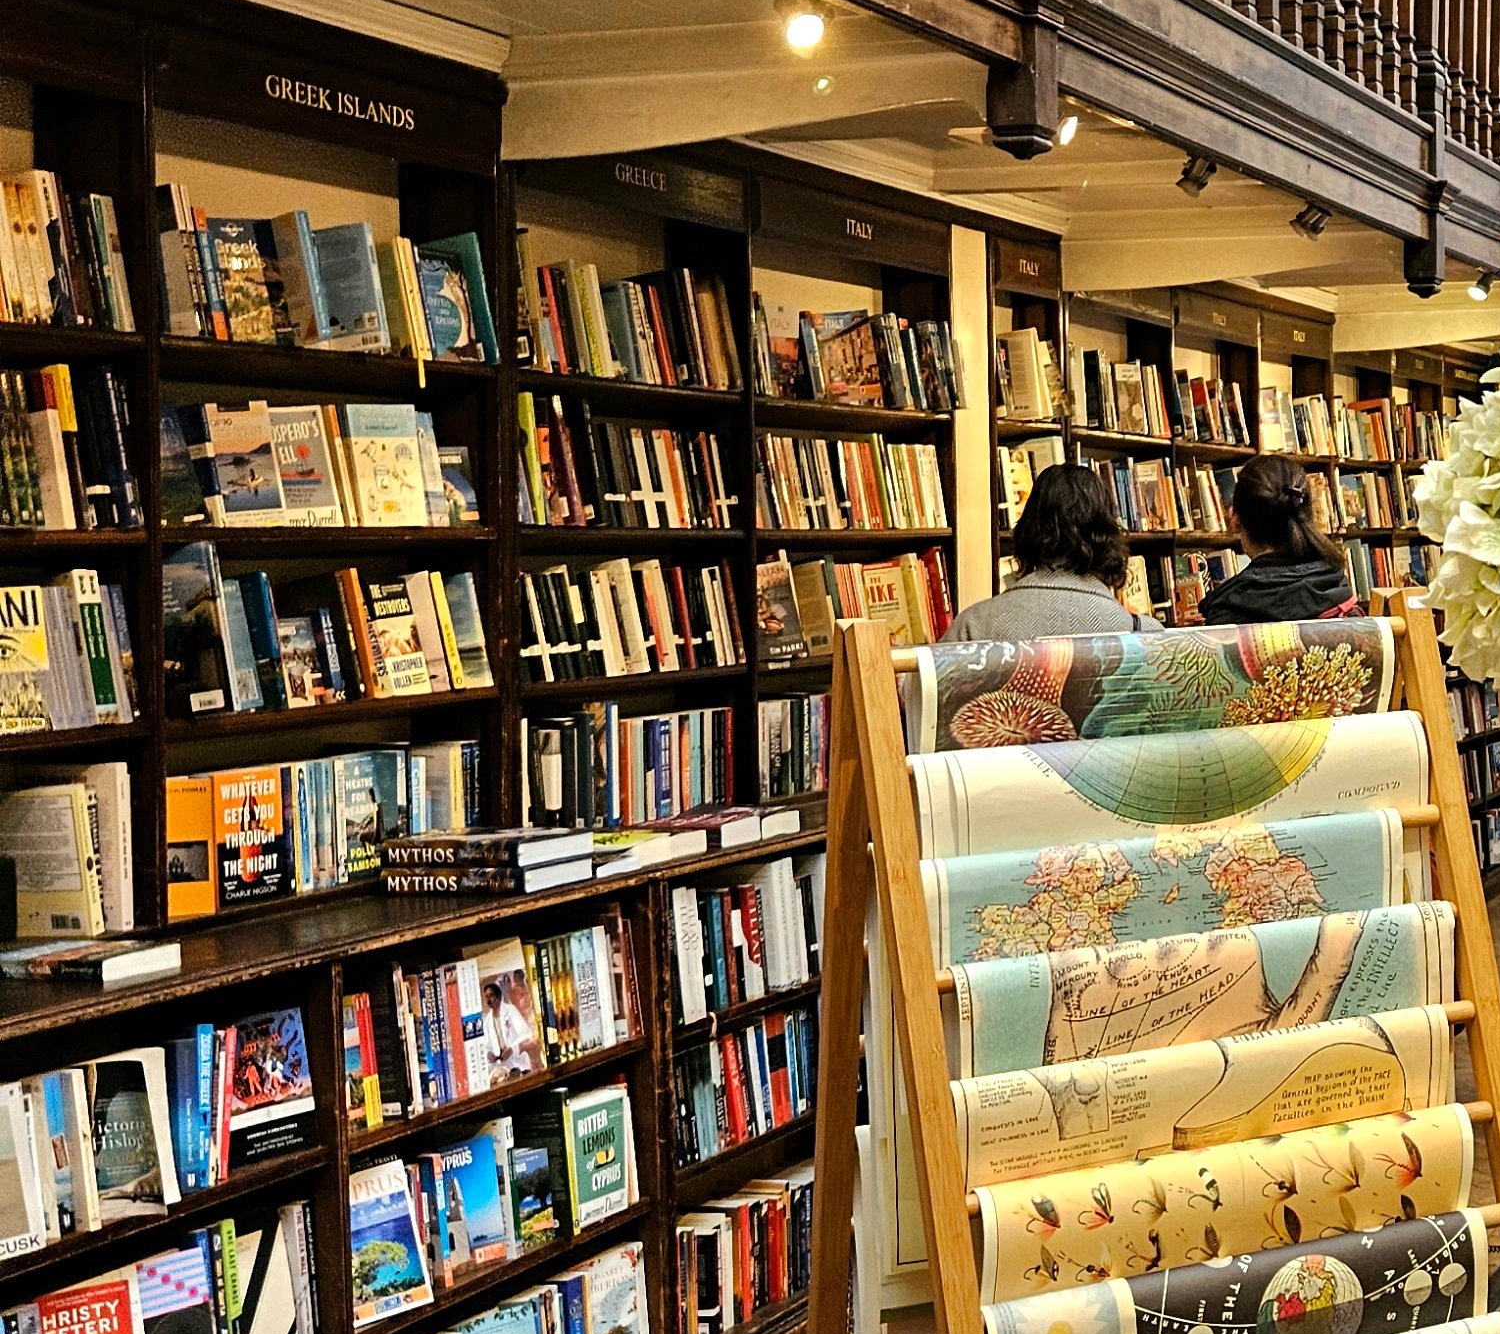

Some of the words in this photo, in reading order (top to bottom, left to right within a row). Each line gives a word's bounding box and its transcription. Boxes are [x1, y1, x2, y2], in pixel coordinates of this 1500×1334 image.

[265, 74, 332, 112] GREEK
[337, 91, 415, 130] ISLANDS
[615, 163, 668, 193] GREECE
[846, 218, 874, 241] ITALY
[213, 236, 260, 257] Greek
[1019, 259, 1040, 277] ITALY
[374, 597, 411, 617] DESTROYERS
[220, 778, 276, 799] WHATEVER
[224, 806, 250, 825] GETS
[254, 803, 275, 821] YOU
[224, 829, 276, 850] THROUGH
[350, 847, 375, 860] POLLY
[388, 848, 455, 864] MYTHOS
[223, 860, 244, 877] THE
[245, 854, 278, 874] NIGHT
[387, 876, 458, 893] MYTHOS
[1365, 918, 1400, 992] INTELLECT
[1078, 1002, 1108, 1020] LINE
[1120, 995, 1137, 1010] OF
[1143, 987, 1165, 1005] THE
[1168, 964, 1213, 996] HEART.
[1106, 1028, 1135, 1047] LINE
[1151, 1014, 1165, 1028] OF
[1168, 1005, 1194, 1024] THE
[1199, 970, 1241, 1004] HEAD.
[1281, 1086, 1314, 1100] General
[1315, 1081, 1348, 1095] Regions
[1349, 1075, 1358, 1087] of
[1359, 1073, 1372, 1085] the
[1373, 1069, 1392, 1081] FACE
[1304, 1072, 1323, 1085] MAP
[1324, 1067, 1358, 1082] showing
[1359, 1065, 1373, 1075] the
[1273, 1101, 1292, 1113] that
[1296, 1098, 1312, 1108] are
[1315, 1089, 1352, 1106] governed
[1355, 1087, 1366, 1098] by
[1368, 1082, 1391, 1094] their
[1272, 1110, 1317, 1123] Faculties
[1321, 1104, 1333, 1113] in
[1337, 1099, 1354, 1110] the
[577, 1109, 608, 1139] BITTER
[582, 1127, 616, 1156] LEMONS
[586, 1153, 598, 1172] of
[591, 1166, 622, 1193] CYPRUS
[42, 1300, 120, 1330] HRISTY
